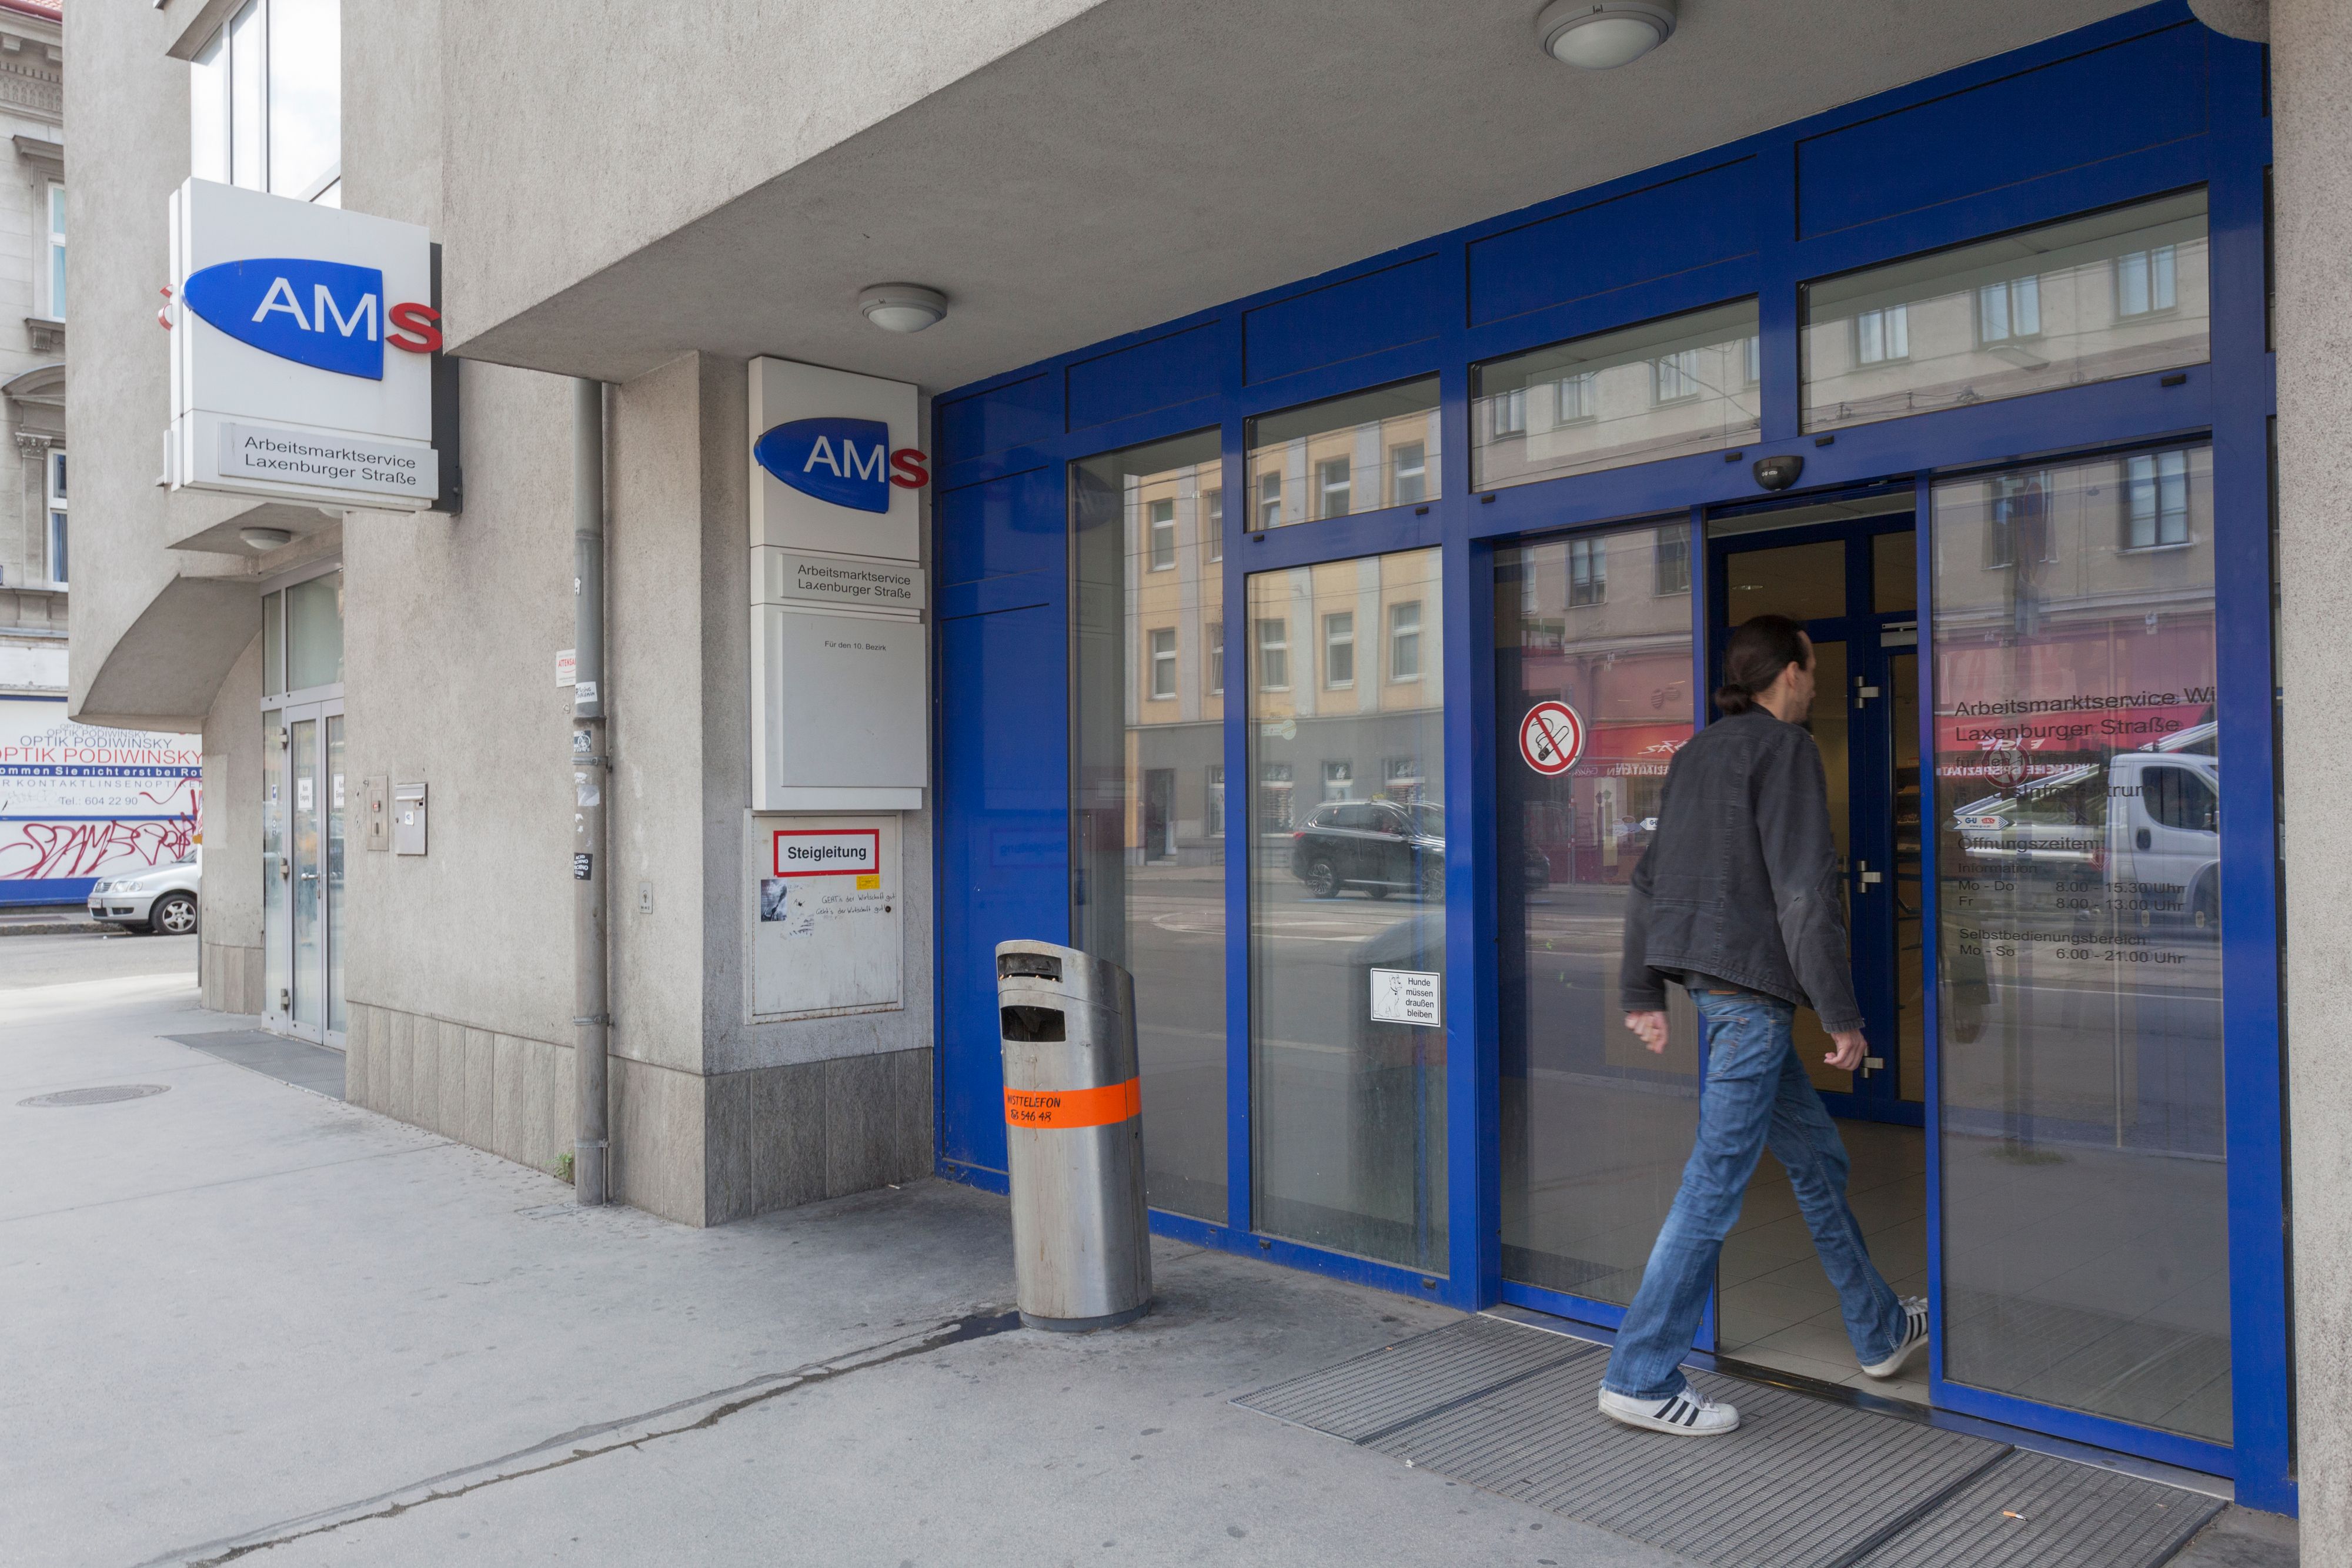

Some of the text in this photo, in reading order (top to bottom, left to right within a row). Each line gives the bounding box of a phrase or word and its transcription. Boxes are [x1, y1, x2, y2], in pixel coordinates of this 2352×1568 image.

[251, 276, 442, 353] AMS
[244, 436, 416, 469] Arbeitsmarktservice
[803, 435, 930, 489] AMS
[245, 454, 416, 486] Laxenburger Straße
[797, 564, 911, 586] Arbeitsmarktservice
[798, 579, 911, 599] Laxenburger Straße
[1954, 686, 2215, 717] Arbeitsmarktservice Wi
[47, 728, 148, 740] OPTIK PODIWINSKY
[1956, 716, 2180, 742] Laxenburger Straße
[20, 735, 172, 749] OPTIK PODIWINSKY
[0, 747, 203, 765] PTIK PODIWINSKY
[55, 766, 78, 775] Sie
[83, 767, 119, 776] nicht
[123, 768, 151, 777] erst
[155, 768, 176, 777] bei
[59, 796, 138, 805] Tel.: 604 22 90
[787, 845, 867, 862] Steigleitung
[1957, 862, 2037, 874] Information
[1959, 880, 1980, 891] Mo
[1994, 880, 2014, 891] Do
[2056, 882, 2088, 892] 8.00
[2106, 882, 2147, 894] 15.30
[2153, 883, 2184, 894] Uhr
[885, 892, 896, 902] gut
[1959, 895, 1974, 906] Fr
[2056, 898, 2089, 909] 8.00
[2106, 899, 2148, 911] 13.00
[2153, 900, 2185, 911] Uhr
[1959, 928, 2146, 945] Selbstbedienungsbereich
[1959, 944, 1981, 955] Mo
[1996, 945, 2015, 957] So
[2056, 948, 2089, 960] 6.00
[2104, 950, 2149, 962] 21.00
[2154, 952, 2186, 964] Uhr
[1408, 977, 1431, 987] Hunde
[1406, 988, 1434, 998] müssen
[1405, 998, 1434, 1008] draußen
[1407, 1008, 1433, 1019] bleiben
[1007, 1094, 1061, 1108] MISTTELEFON
[1021, 1111, 1052, 1122] 546 48
